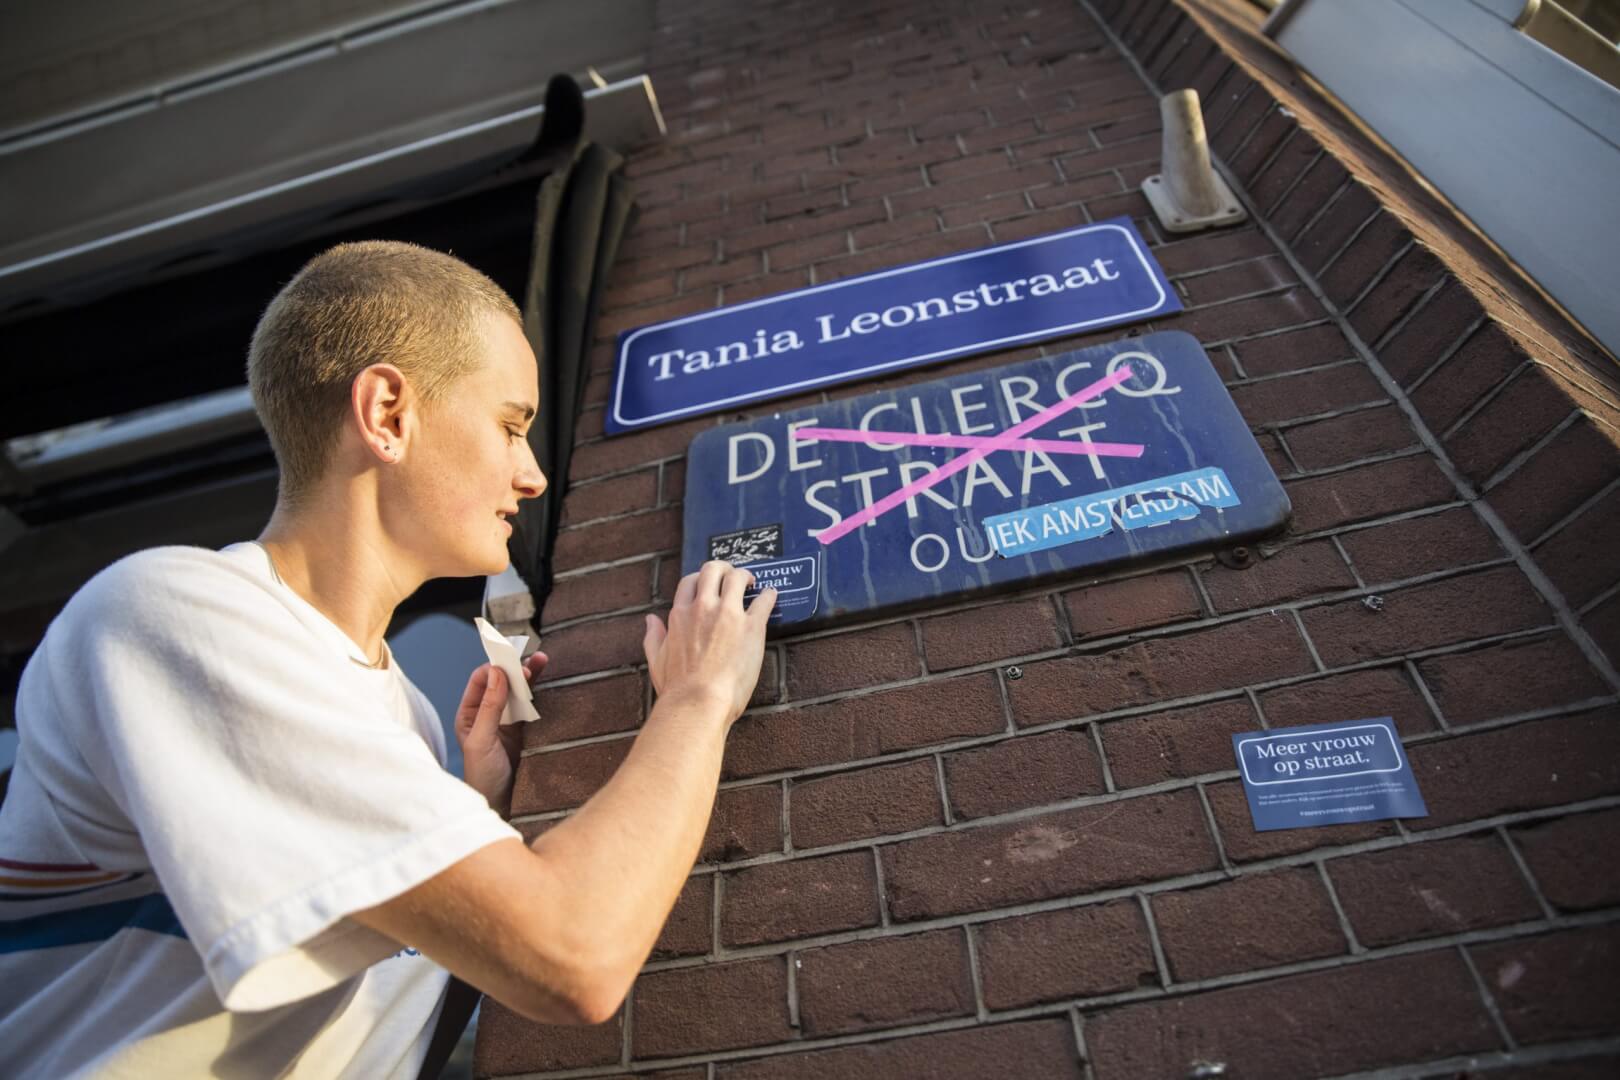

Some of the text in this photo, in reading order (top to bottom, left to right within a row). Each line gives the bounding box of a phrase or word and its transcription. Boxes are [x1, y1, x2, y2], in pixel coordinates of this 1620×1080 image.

[649, 257, 1120, 383] Tania Leonstraat
[728, 351, 1181, 484] DE CLERCQ
[805, 421, 1107, 538] STRAAT
[749, 576, 792, 590] traat.
[755, 564, 803, 579] vrouw
[1255, 734, 1376, 759] Meer vrouw
[1273, 750, 1370, 776] op straat.
